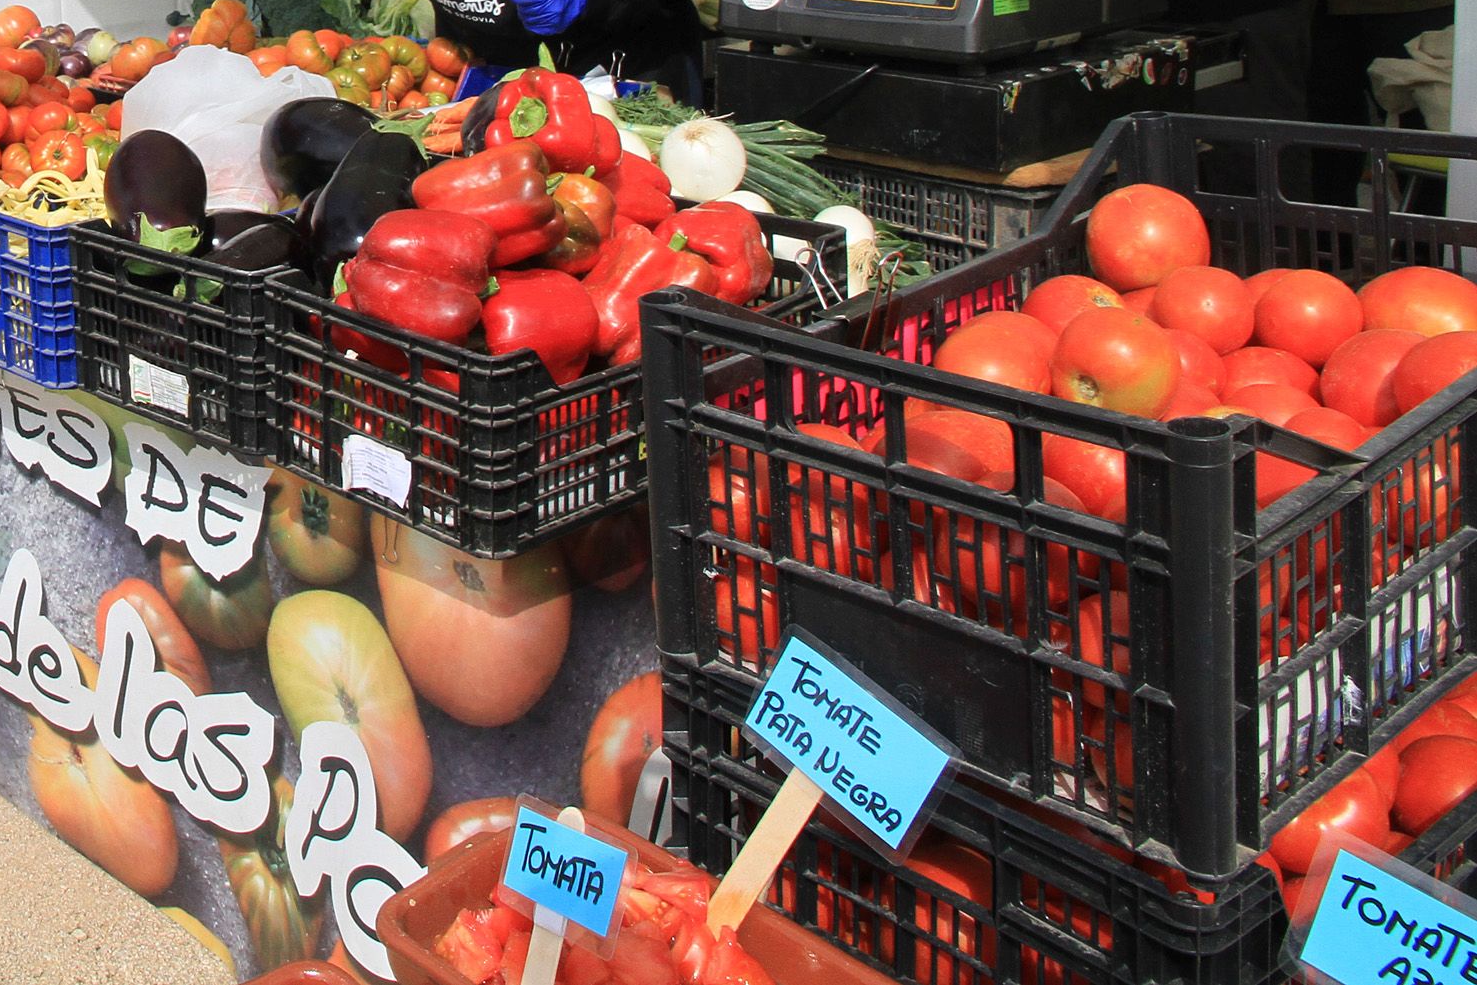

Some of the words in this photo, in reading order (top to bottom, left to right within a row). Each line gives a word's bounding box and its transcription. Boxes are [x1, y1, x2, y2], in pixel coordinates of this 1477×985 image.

[140, 442, 248, 547] DE
[112, 632, 250, 803] las
[790, 656, 882, 756] TOMATE
[755, 690, 813, 757] PATA
[812, 746, 903, 833] NEGRA
[519, 822, 604, 905] TOMATA
[1341, 874, 1477, 984] TOMATE
